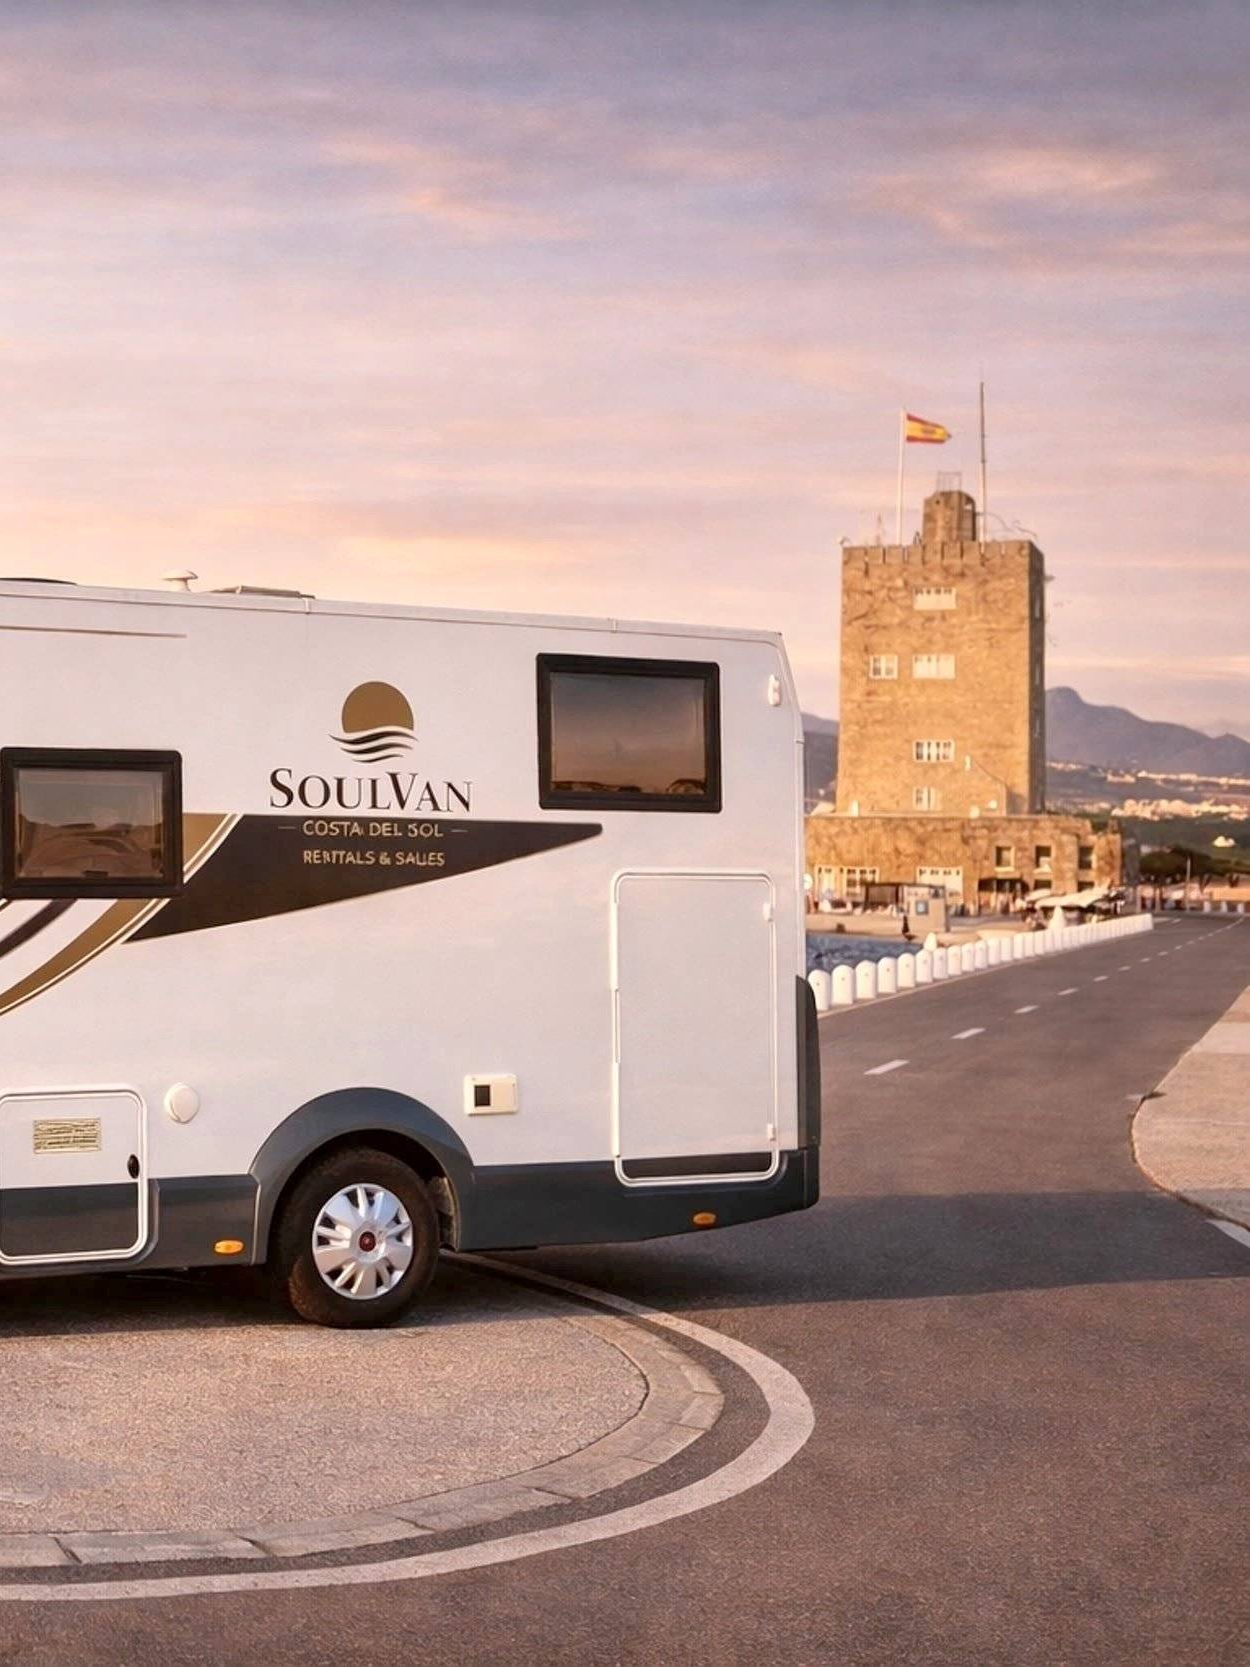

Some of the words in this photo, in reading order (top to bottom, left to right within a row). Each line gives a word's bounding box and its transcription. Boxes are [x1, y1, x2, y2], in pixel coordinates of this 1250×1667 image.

[302, 819, 364, 837] COSTA
[368, 821, 403, 837] DEL
[407, 822, 445, 838] SOL
[379, 851, 392, 866] &
